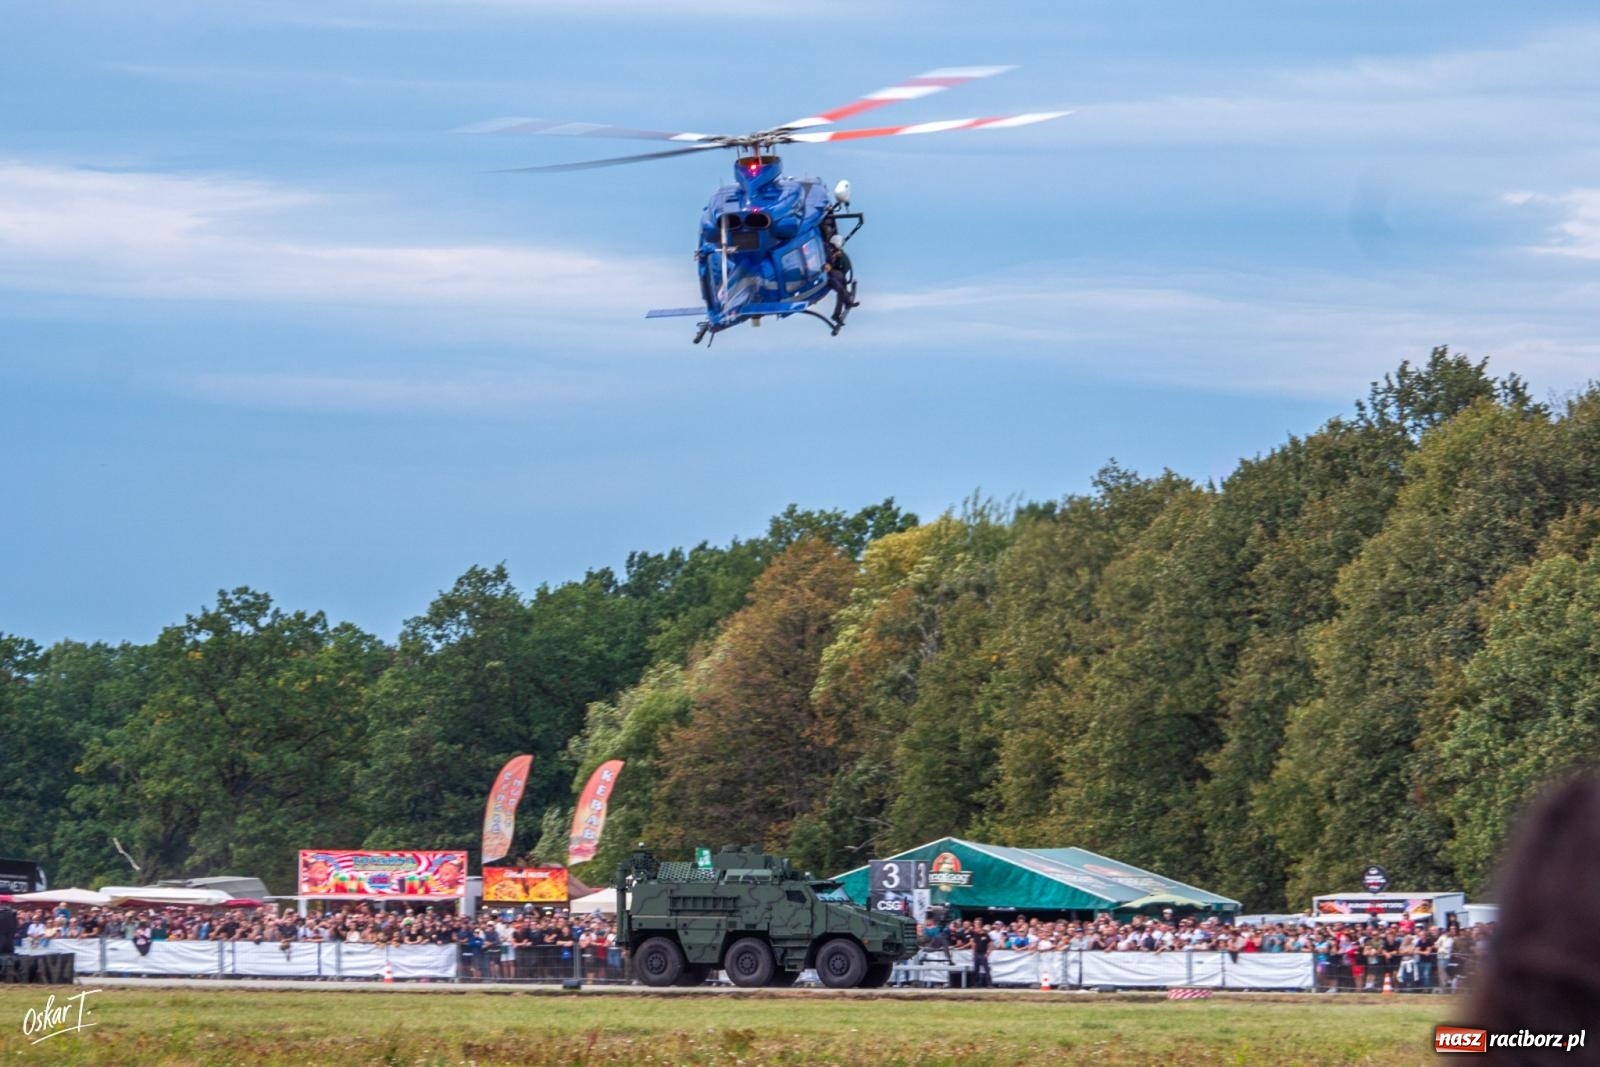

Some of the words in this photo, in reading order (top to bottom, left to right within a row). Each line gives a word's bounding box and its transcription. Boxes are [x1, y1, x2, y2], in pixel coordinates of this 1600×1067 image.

[582, 769, 613, 840] KEBAB
[882, 863, 900, 888] 3
[917, 863, 926, 888] 3
[877, 900, 901, 911] CSG
